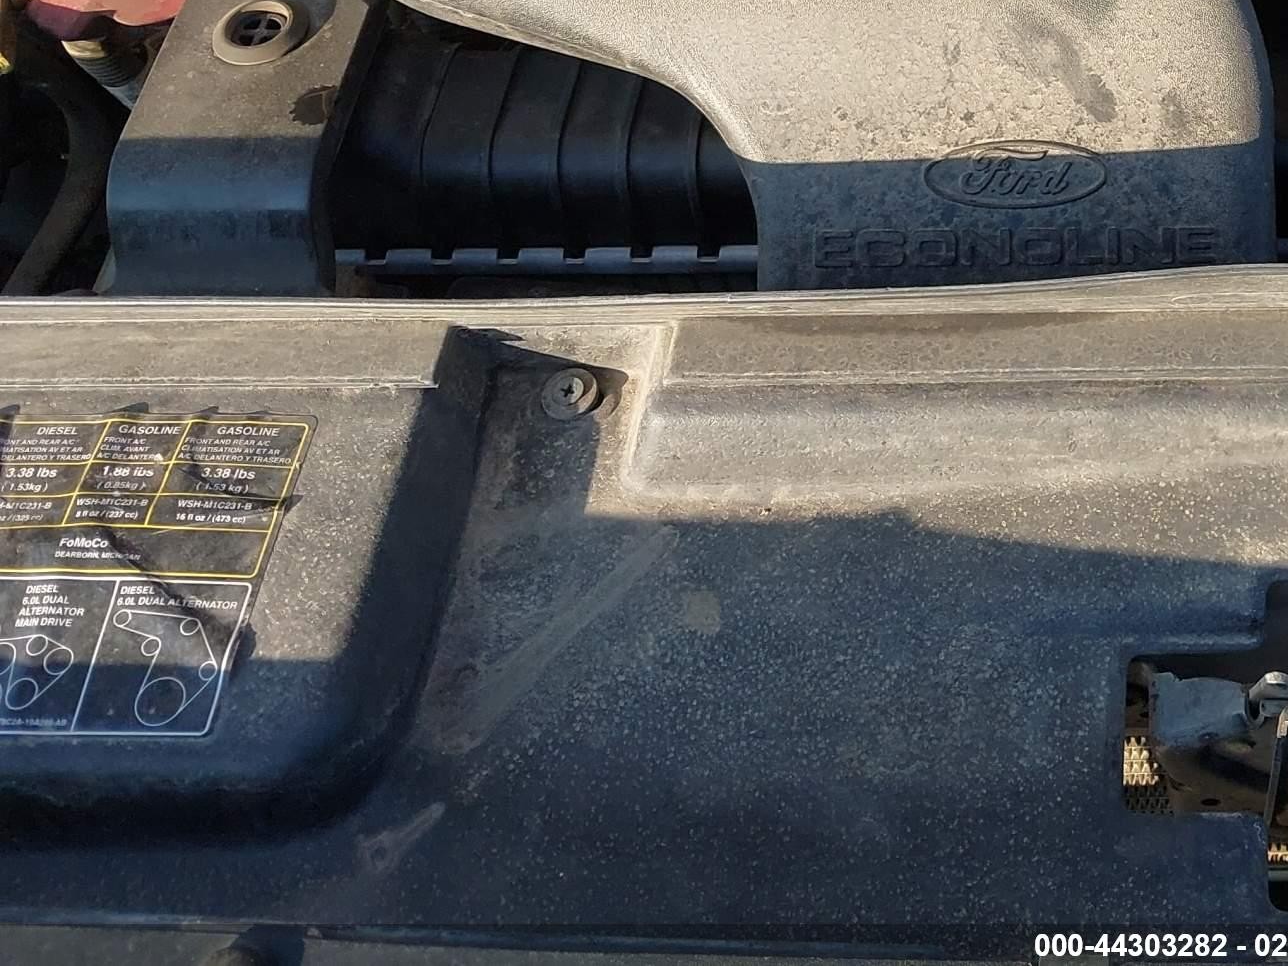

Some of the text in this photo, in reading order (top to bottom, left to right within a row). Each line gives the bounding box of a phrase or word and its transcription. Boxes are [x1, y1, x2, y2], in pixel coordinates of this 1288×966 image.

[960, 147, 1071, 197] Ford
[813, 227, 1218, 269] ECONOLINE
[36, 426, 78, 435] DIESEL
[119, 424, 182, 435] GASOLINE
[217, 426, 280, 437] GASOLINE
[104, 436, 132, 444] FRONT
[184, 437, 213, 445] FRONT
[111, 453, 162, 461] DELANTER
[252, 456, 291, 464] TRASERO
[6, 467, 58, 478] 3.38 lbs
[103, 465, 154, 477] 1.88 lbs
[201, 467, 256, 480] 3.38 lbs
[59, 537, 108, 548] FoMoCo
[26, 585, 59, 594] DIESEL
[120, 585, 155, 595] DIESEL
[22, 595, 70, 605] 6.0L DUAL
[116, 596, 238, 610] 6.0L DUAL ALTERNATOR
[18, 606, 85, 617] ALTERNATOR
[15, 617, 73, 627] MAIN DRIVE
